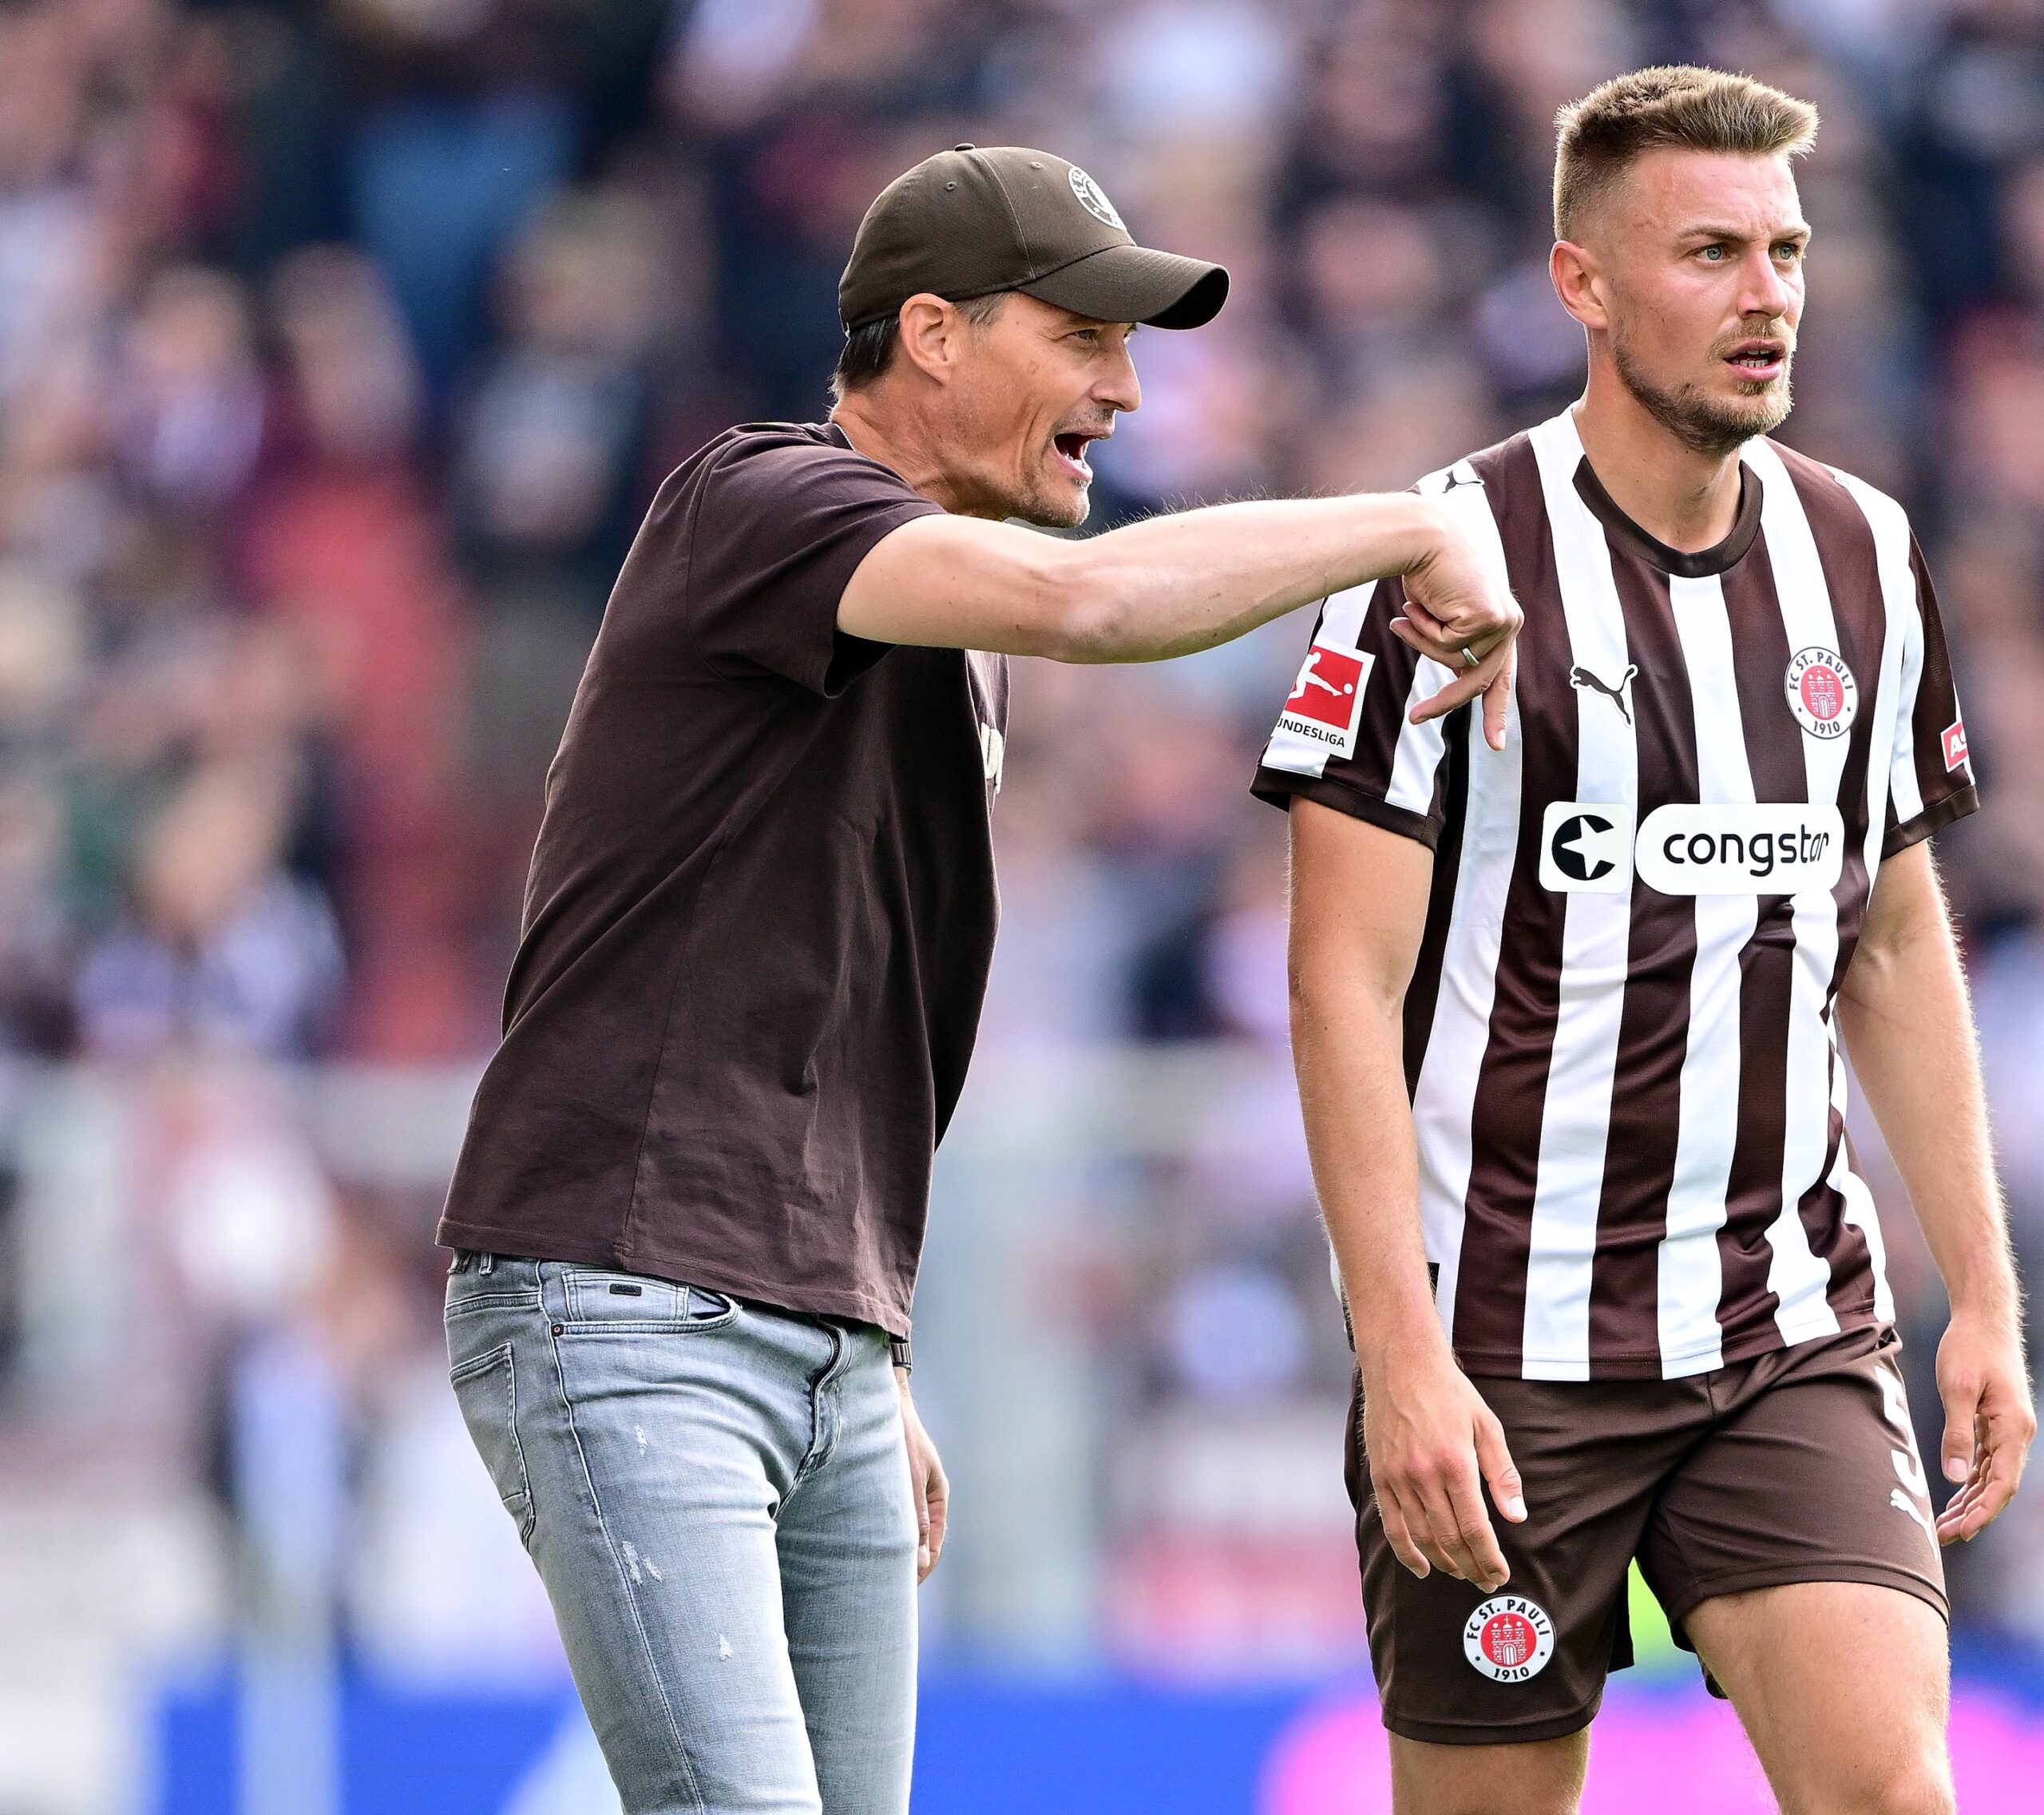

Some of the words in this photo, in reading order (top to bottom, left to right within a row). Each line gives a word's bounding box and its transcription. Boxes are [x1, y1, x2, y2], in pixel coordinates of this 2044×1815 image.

[1788, 673, 1799, 691] FC
[1796, 654, 1813, 671] ST.
[1816, 651, 1853, 690] PAULI
[1277, 717, 1345, 748] UNDESLIGA
[1813, 720, 1840, 735] 1910
[1662, 823, 1830, 877] congstar
[1466, 1622, 1481, 1640] FC
[1478, 1602, 1501, 1620] ST.
[1507, 1599, 1551, 1635] PAULI
[1493, 1666, 1530, 1681] 1910
